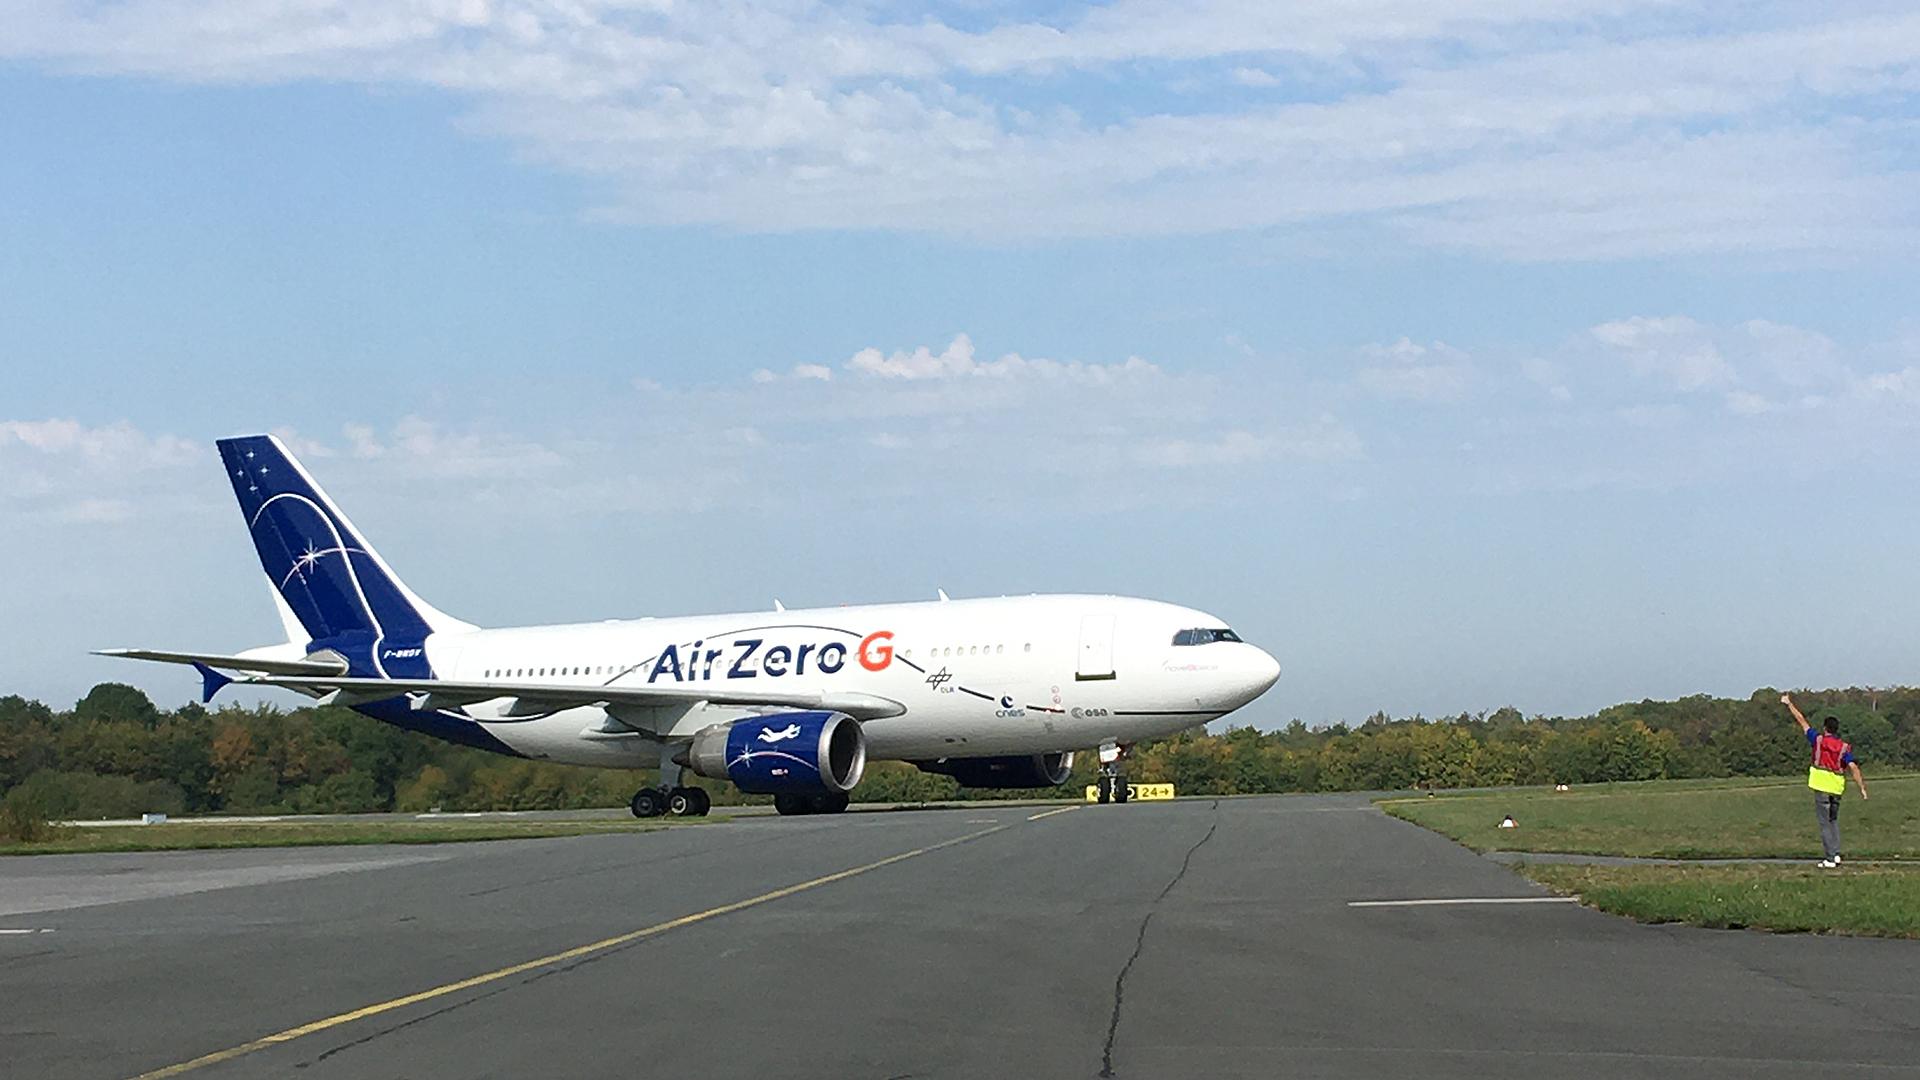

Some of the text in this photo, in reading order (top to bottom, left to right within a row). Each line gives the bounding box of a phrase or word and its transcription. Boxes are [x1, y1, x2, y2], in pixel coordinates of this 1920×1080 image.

[647, 630, 895, 684] Air Zero G
[1142, 787, 1158, 798] 24
